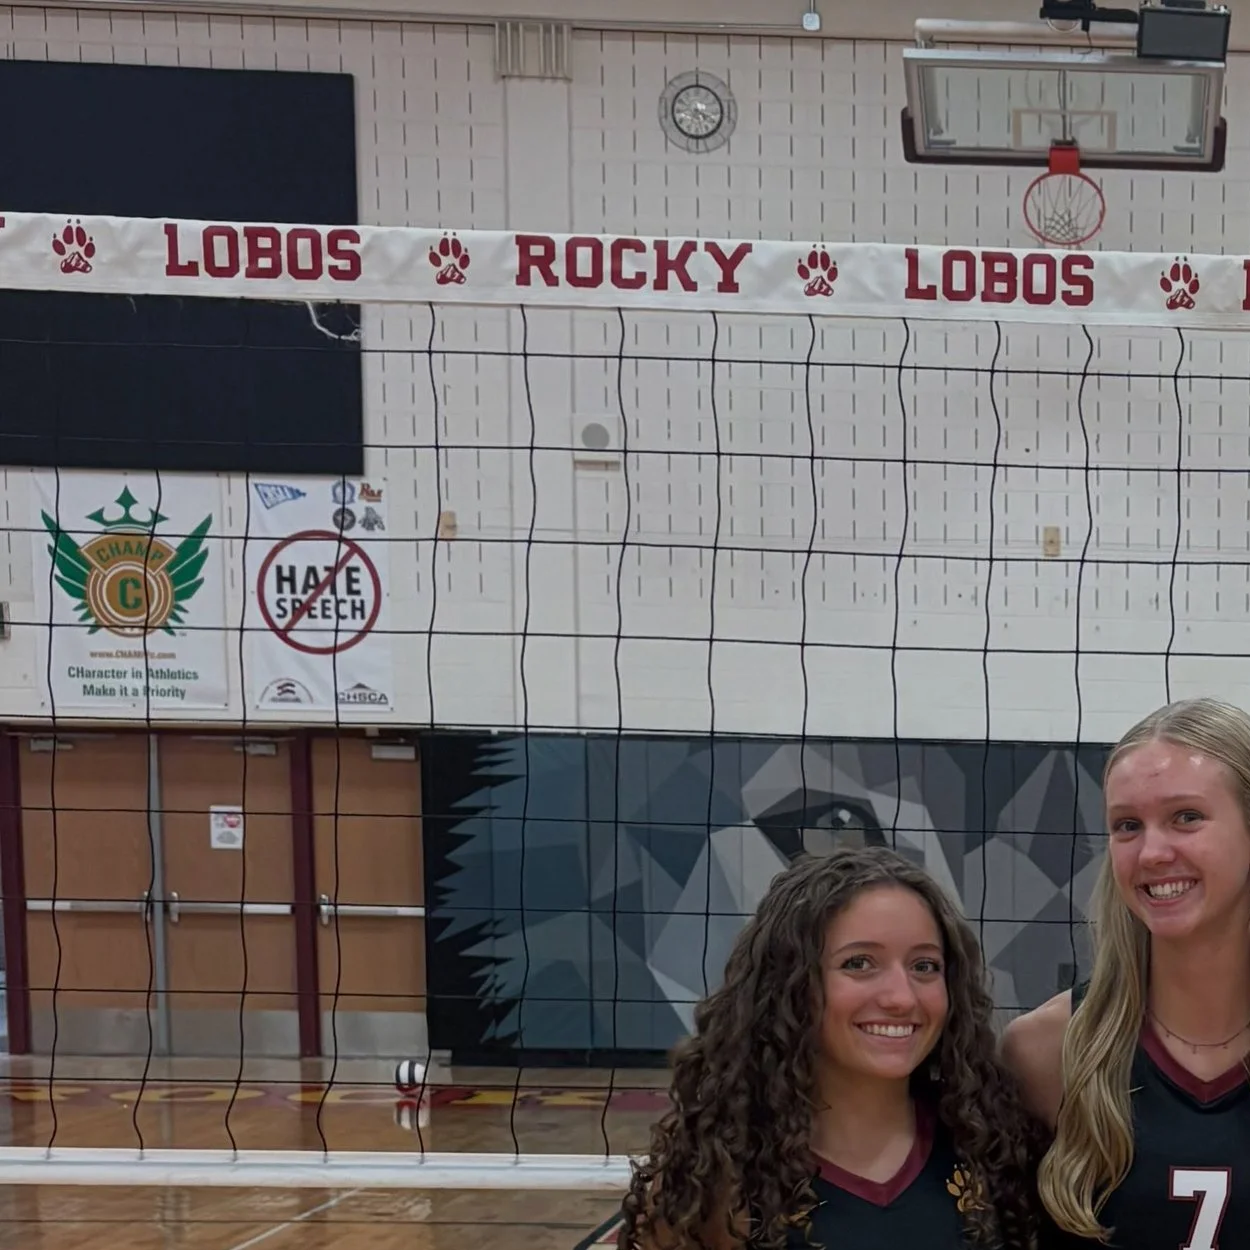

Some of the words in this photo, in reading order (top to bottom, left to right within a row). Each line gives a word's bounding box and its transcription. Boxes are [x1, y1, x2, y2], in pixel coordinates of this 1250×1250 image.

[164, 223, 362, 281] LOBOS
[514, 234, 753, 293] ROCKY
[904, 248, 1095, 306] LOBOS
[96, 541, 165, 562] CHAMP
[119, 577, 142, 610] C
[275, 565, 361, 595] HATE
[276, 598, 366, 621] SPEECH
[68, 665, 128, 680] CHaracter
[131, 667, 142, 680] in
[147, 667, 200, 681] Athletics
[82, 684, 115, 697] Make
[119, 685, 128, 697] it
[132, 688, 139, 697] a
